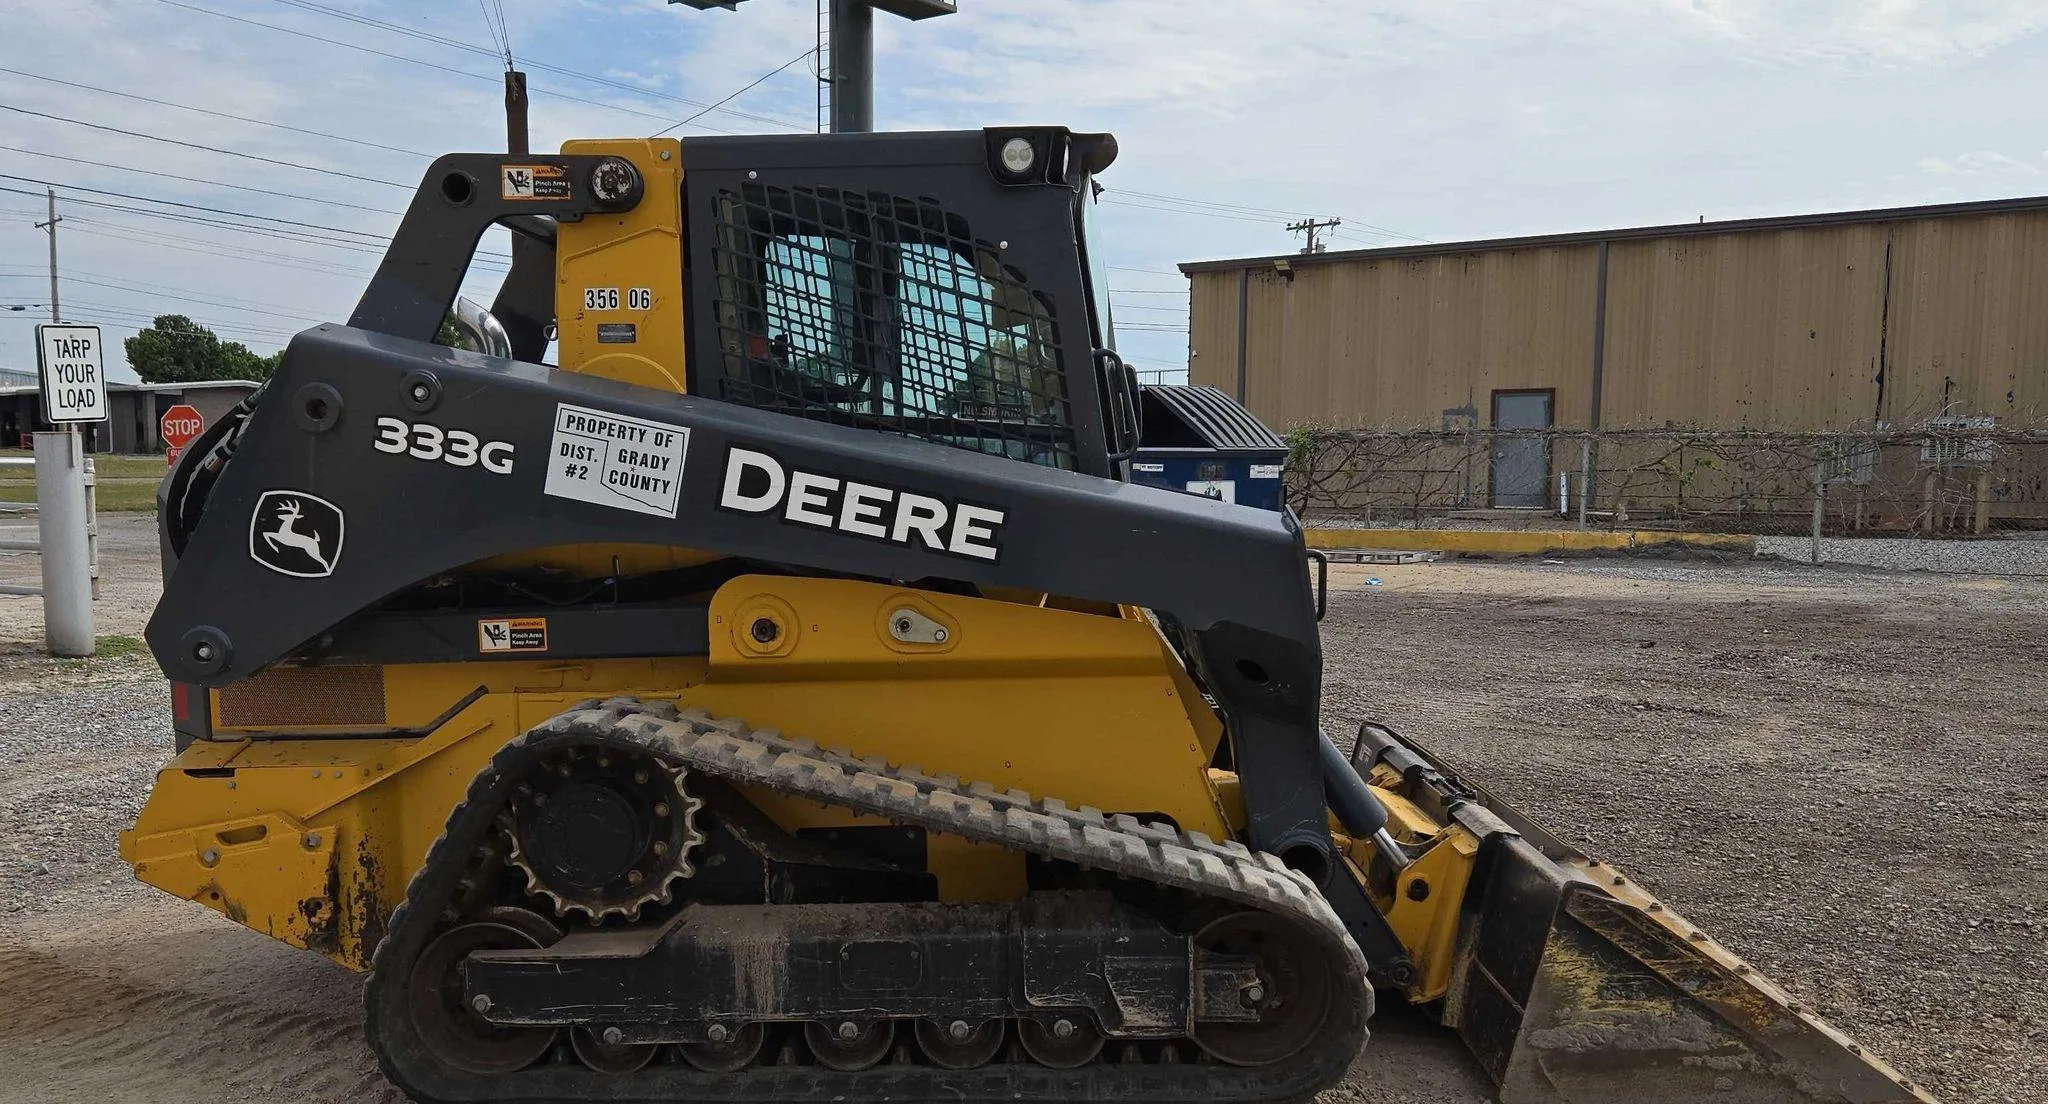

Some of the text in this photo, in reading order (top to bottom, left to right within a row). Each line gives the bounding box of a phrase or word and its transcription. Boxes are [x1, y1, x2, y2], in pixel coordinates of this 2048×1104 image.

[586, 289, 650, 309] 356 06
[53, 339, 91, 359] TARP
[54, 364, 96, 384] YOUR
[58, 388, 96, 409] LOAD
[165, 419, 200, 436] STOP
[565, 414, 674, 449] PROPERTY OF
[374, 417, 515, 474] 333G
[560, 442, 671, 472] DIST. GRADY
[565, 463, 671, 494] #2 COUNTY
[720, 447, 1005, 560] DEERE
